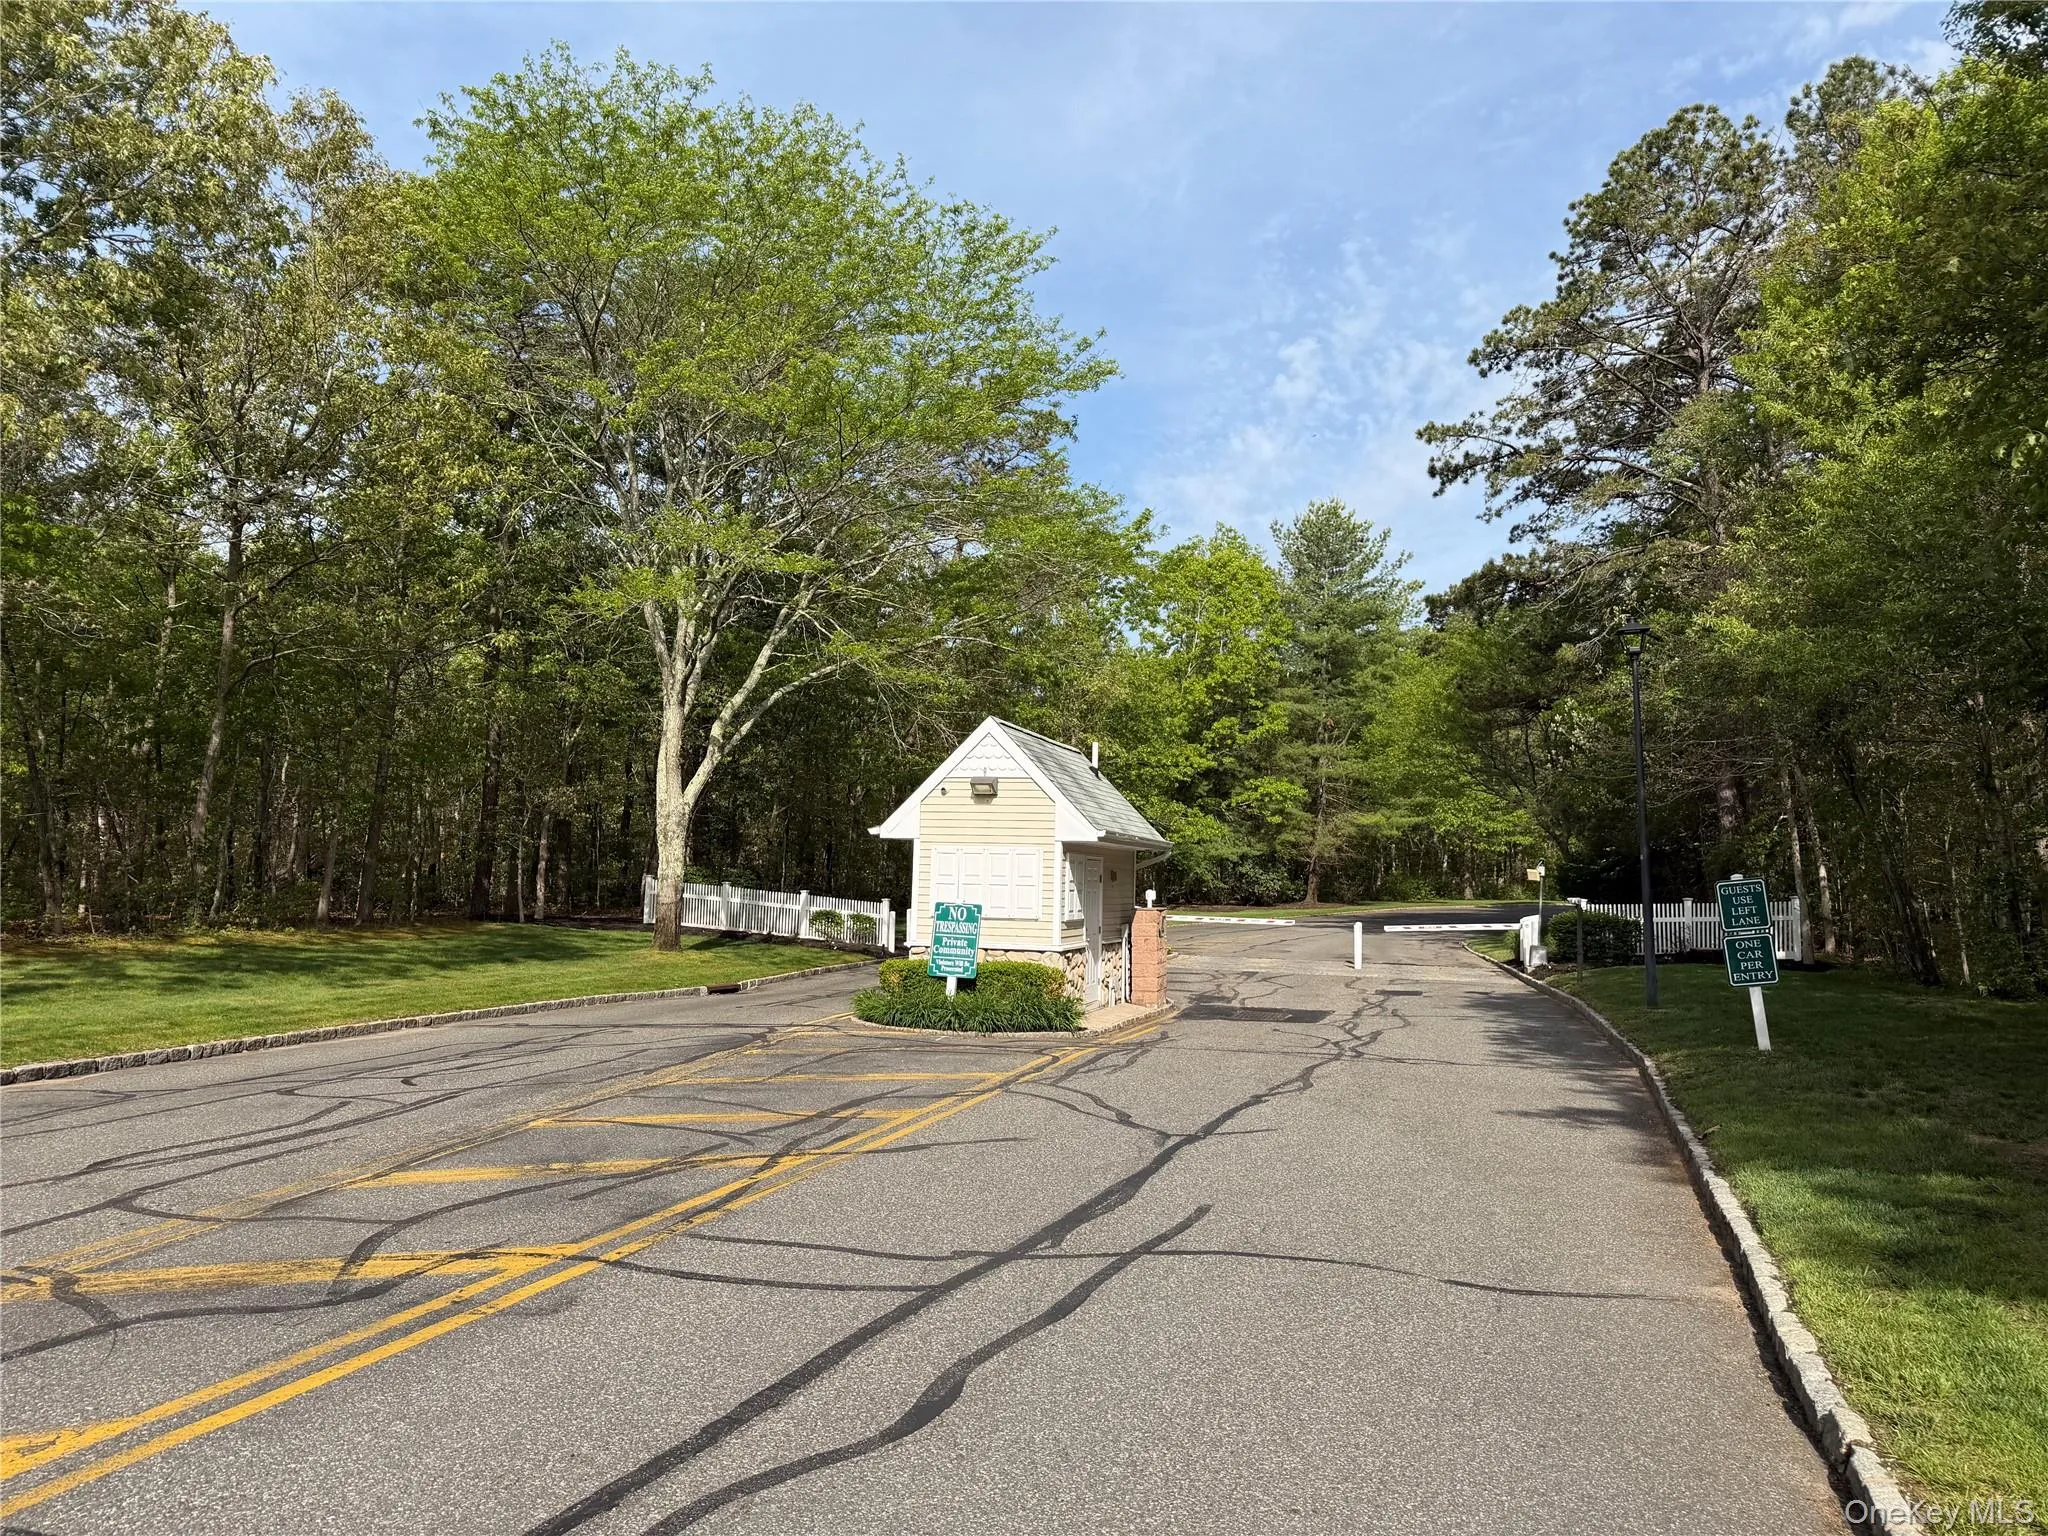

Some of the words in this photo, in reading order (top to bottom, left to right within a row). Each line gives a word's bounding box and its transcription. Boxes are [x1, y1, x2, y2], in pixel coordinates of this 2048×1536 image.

[1720, 884, 1762, 895] GUESTS
[1732, 895, 1754, 905] USE
[948, 906, 968, 921] NO
[1731, 905, 1758, 916] LEFT
[1731, 916, 1761, 926] LANE
[935, 920, 977, 934] TRESPASSING
[941, 937, 968, 947] Private
[1735, 939, 1762, 949] ONE
[933, 945, 975, 957] Community
[1737, 950, 1764, 960] CAR
[1740, 960, 1764, 970] PER
[1733, 970, 1774, 982] ENTRY
